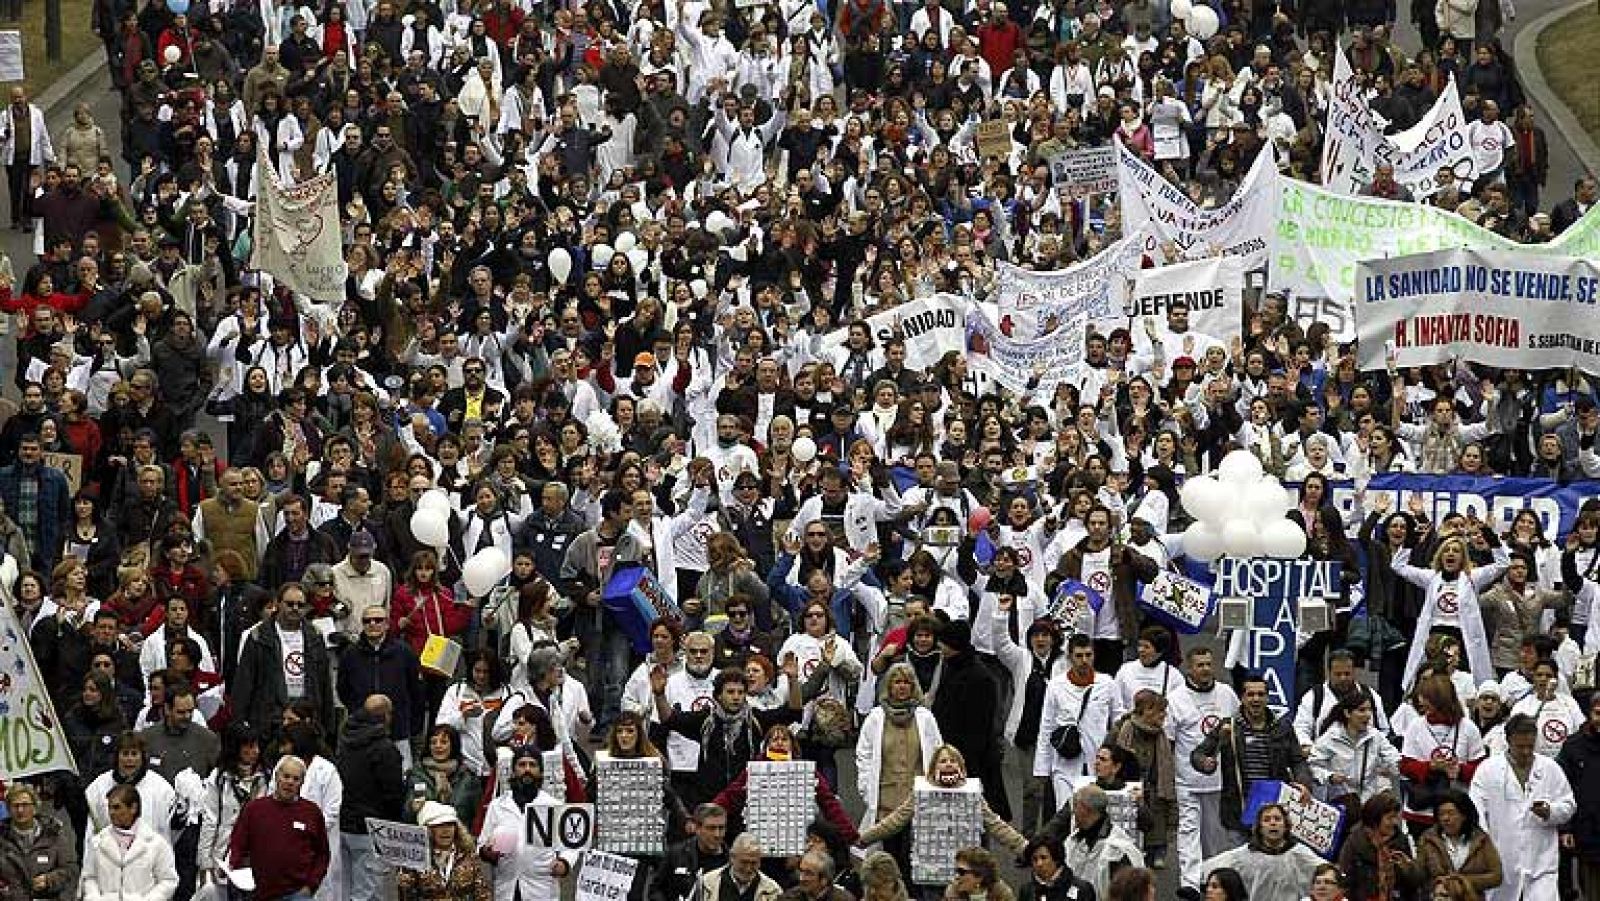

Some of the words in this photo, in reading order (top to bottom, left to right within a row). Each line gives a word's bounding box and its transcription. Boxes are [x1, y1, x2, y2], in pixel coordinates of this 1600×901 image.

[1366, 274, 1386, 303] LA
[1389, 266, 1461, 299] SANIDAD
[1466, 264, 1487, 292] NO
[1491, 268, 1511, 297] SE
[1515, 270, 1573, 302] VENDE,
[1576, 275, 1599, 304] SE
[1395, 319, 1411, 349] H.
[1414, 313, 1470, 348] INFANTA
[1474, 314, 1520, 349] SOFIA
[1212, 557, 1341, 600] HOSPITAL
[526, 806, 591, 849] NO
